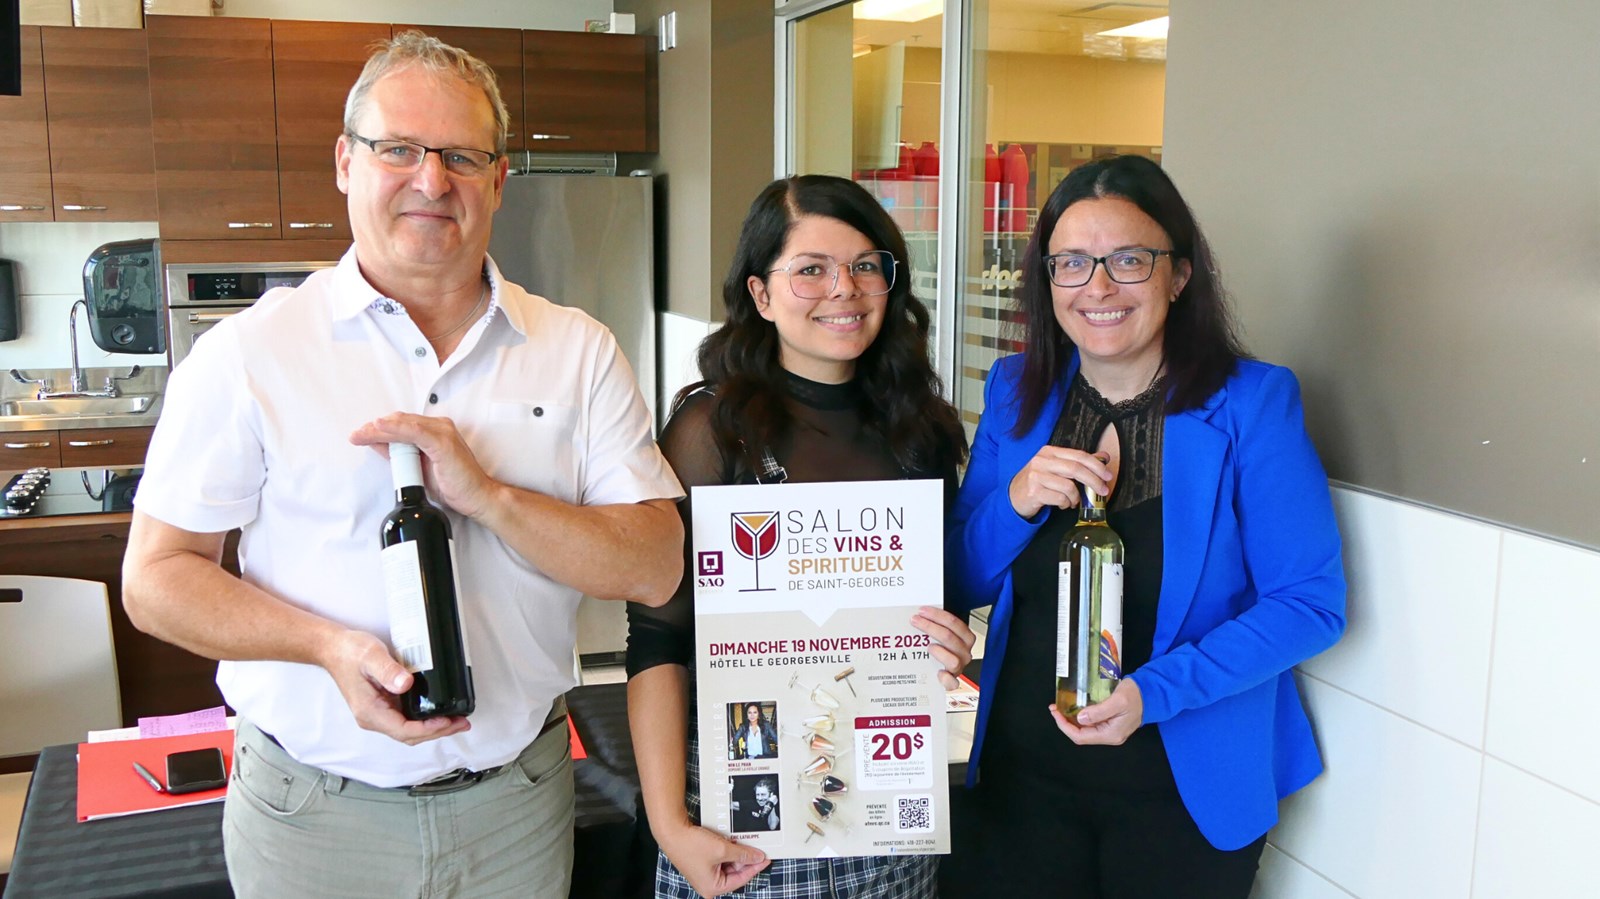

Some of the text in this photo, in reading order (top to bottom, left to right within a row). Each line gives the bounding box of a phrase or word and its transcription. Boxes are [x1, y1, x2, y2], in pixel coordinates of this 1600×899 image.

[787, 507, 904, 534] SALON
[788, 534, 903, 555] DES VINS &
[788, 555, 903, 575] SPIRITUEUX
[698, 577, 724, 588] SAQ
[788, 576, 905, 591] DE SAINT-GEORGES
[709, 634, 931, 656] DIMANCHE 19 NOVEMBRE 2023
[710, 650, 930, 669] HÔTEL LE GEORGESVILLE 12H À 17H
[868, 718, 916, 727] ADMISSION
[871, 732, 924, 761] 20$
